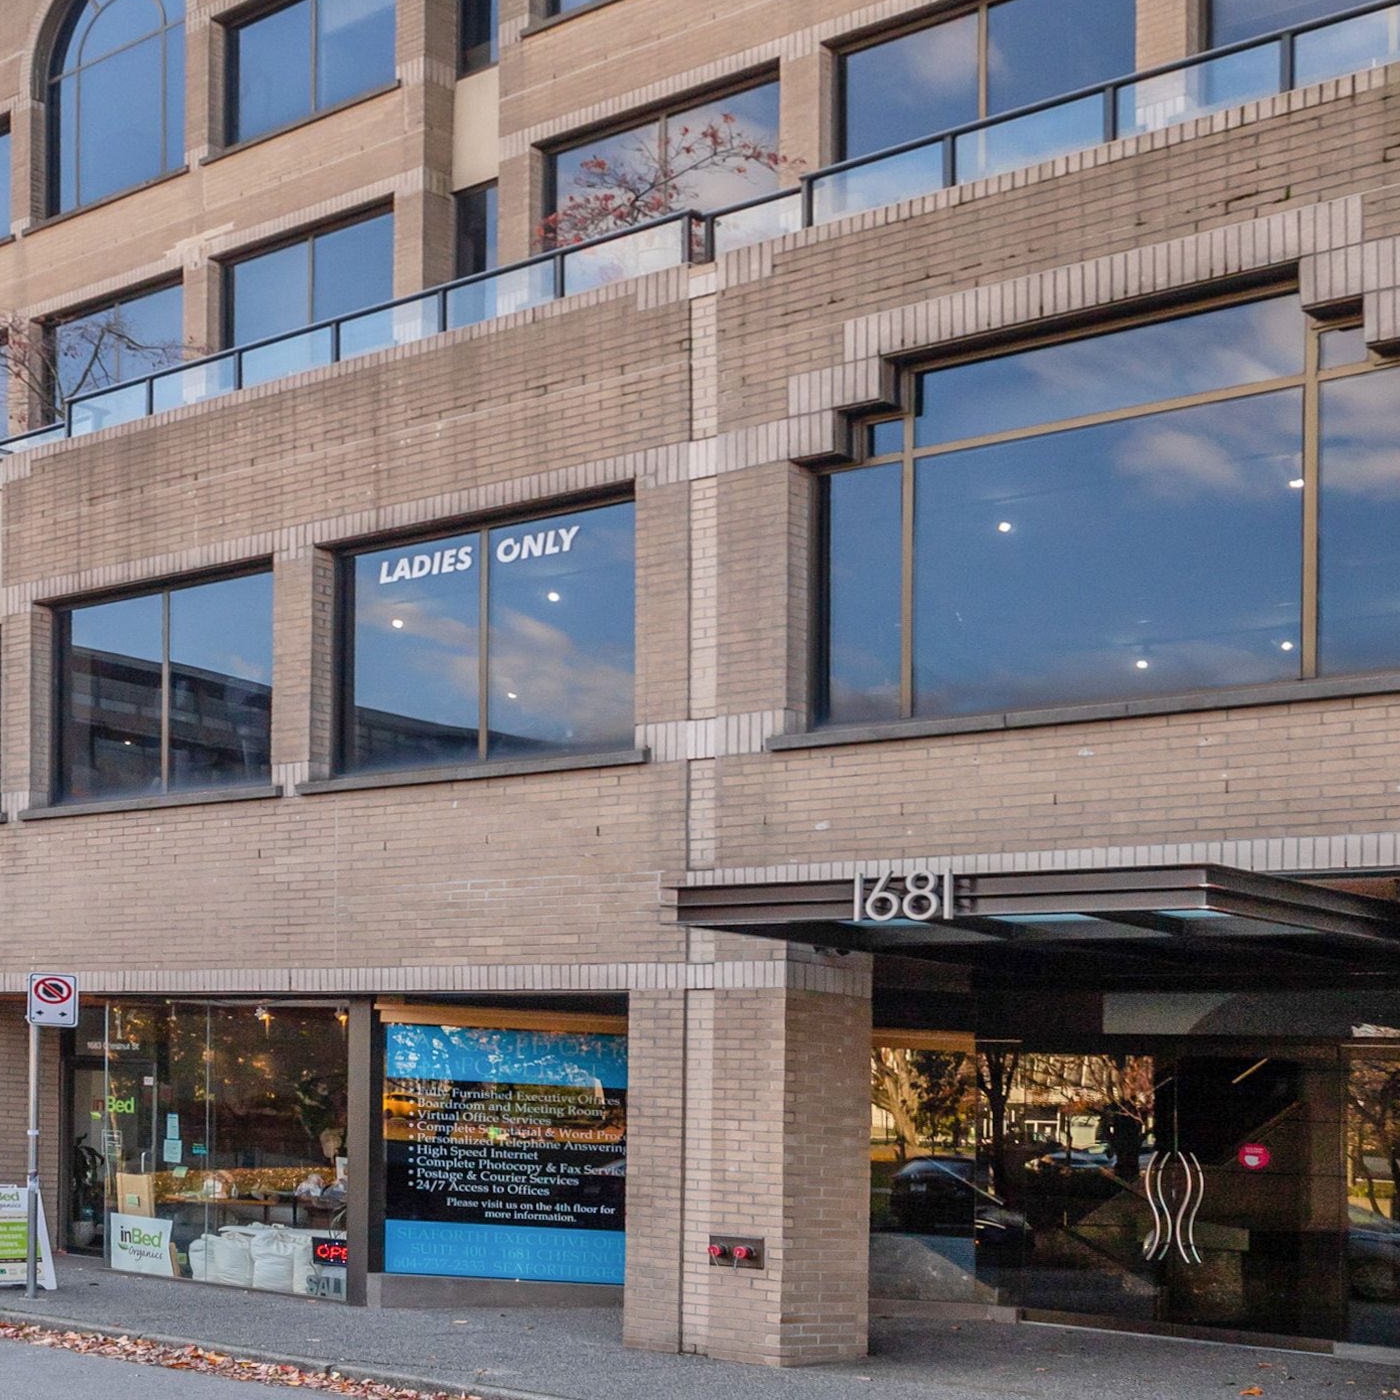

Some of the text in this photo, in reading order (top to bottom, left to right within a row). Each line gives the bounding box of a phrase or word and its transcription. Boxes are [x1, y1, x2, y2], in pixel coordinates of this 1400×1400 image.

[379, 525, 580, 585] LADIES ONLY
[853, 867, 954, 923] 1681
[417, 1087, 449, 1098] Fully
[451, 1088, 513, 1101] Furnished
[516, 1090, 575, 1104] Executive
[417, 1098, 485, 1111] Boardroom
[488, 1100, 511, 1112] and
[515, 1102, 565, 1118] Meeting
[417, 1110, 552, 1126] Virtual Office Services
[416, 1121, 476, 1135] Complete
[478, 1123, 541, 1136] Seretarial
[544, 1127, 556, 1138] &
[559, 1128, 593, 1139] Word
[416, 1132, 495, 1146] Personalized
[499, 1136, 561, 1151] Telephone
[416, 1144, 539, 1160] High Speed Internet
[416, 1155, 476, 1170] Complete
[478, 1158, 543, 1176] Photocopy
[545, 1162, 557, 1173] &
[560, 1163, 582, 1175] Fax
[416, 1167, 580, 1186] Postage & Courier Services
[416, 1179, 551, 1196] 24/7 Access to Offices
[445, 1197, 479, 1208] Please
[481, 1200, 503, 1209] visit
[505, 1201, 518, 1210] us
[535, 1202, 552, 1211] the
[554, 1203, 571, 1212] 4th
[573, 1203, 599, 1214] floor
[600, 1205, 616, 1215] for
[484, 1210, 577, 1223] more information.
[120, 1225, 163, 1248] inBed
[397, 1227, 489, 1243] SEAFORTH
[494, 1231, 589, 1249] EXECUTIVE
[128, 1245, 163, 1261] Organics
[316, 1243, 349, 1260] OPE
[410, 1242, 459, 1256] SUITE
[500, 1246, 532, 1260] 1681
[391, 1255, 487, 1271] 604-737-2333
